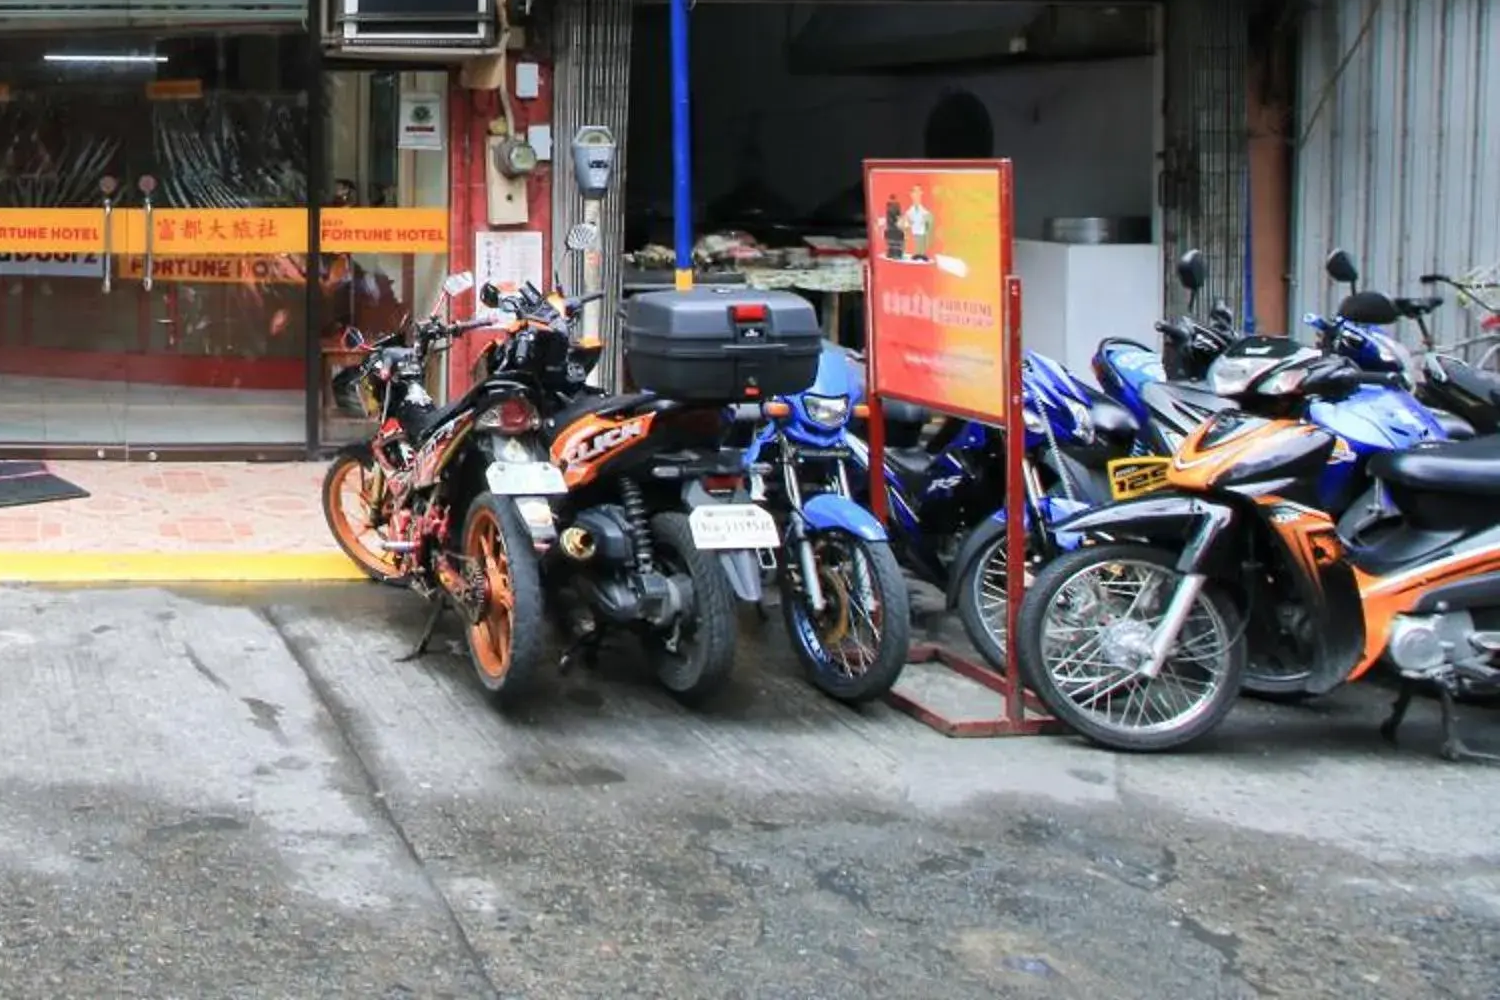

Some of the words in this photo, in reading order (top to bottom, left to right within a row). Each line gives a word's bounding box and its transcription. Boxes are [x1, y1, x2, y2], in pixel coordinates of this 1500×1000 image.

[51, 227, 100, 241] HOTEL
[322, 228, 392, 241] FORTUNE
[396, 228, 445, 241] HOTEL
